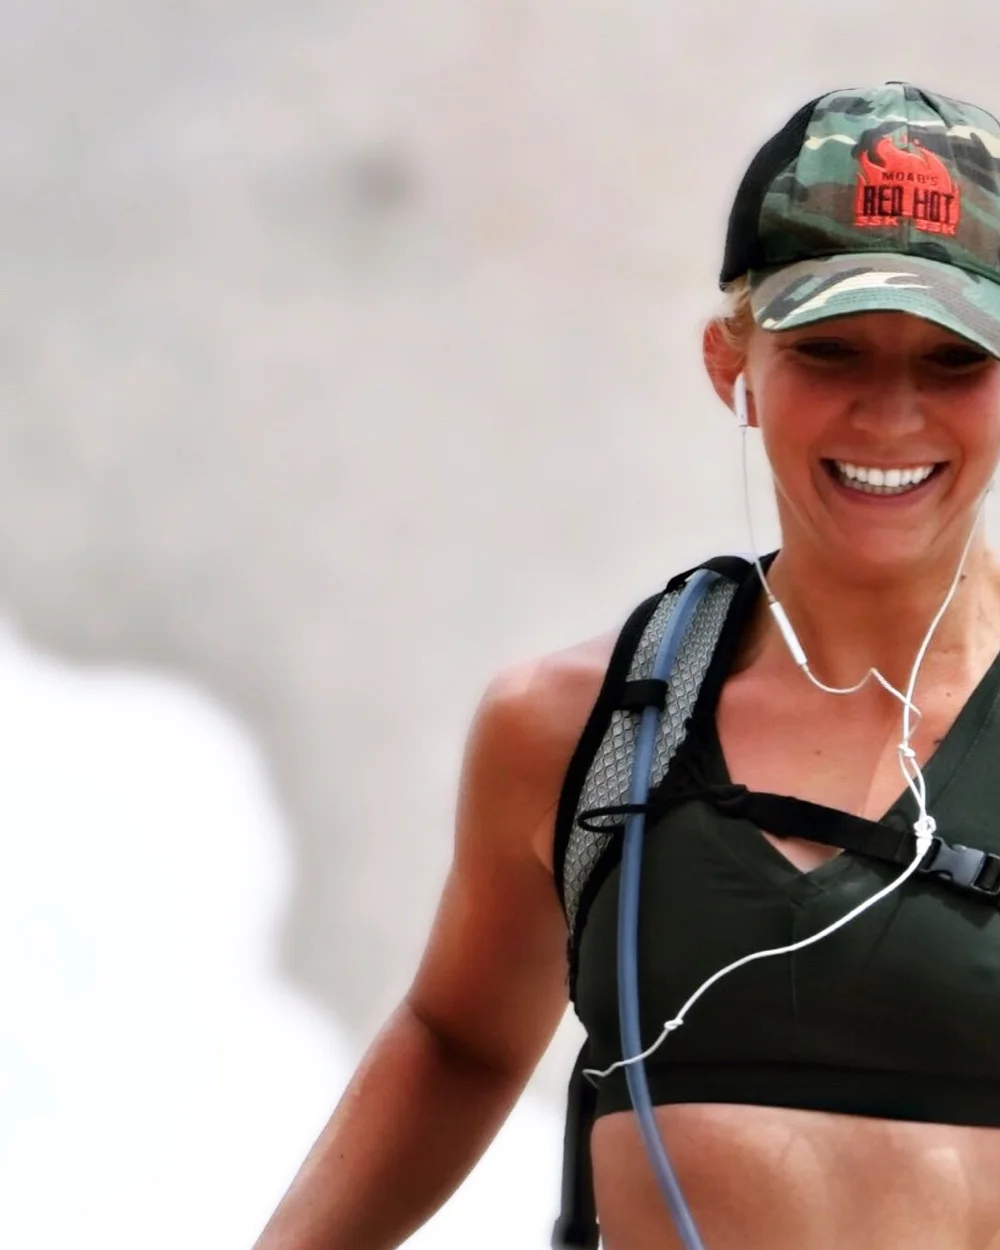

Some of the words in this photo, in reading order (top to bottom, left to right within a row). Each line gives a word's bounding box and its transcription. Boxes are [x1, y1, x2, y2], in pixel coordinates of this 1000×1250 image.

[881, 171, 938, 186] MOAB'S
[863, 185, 904, 217] RED
[912, 188, 954, 223] HOT
